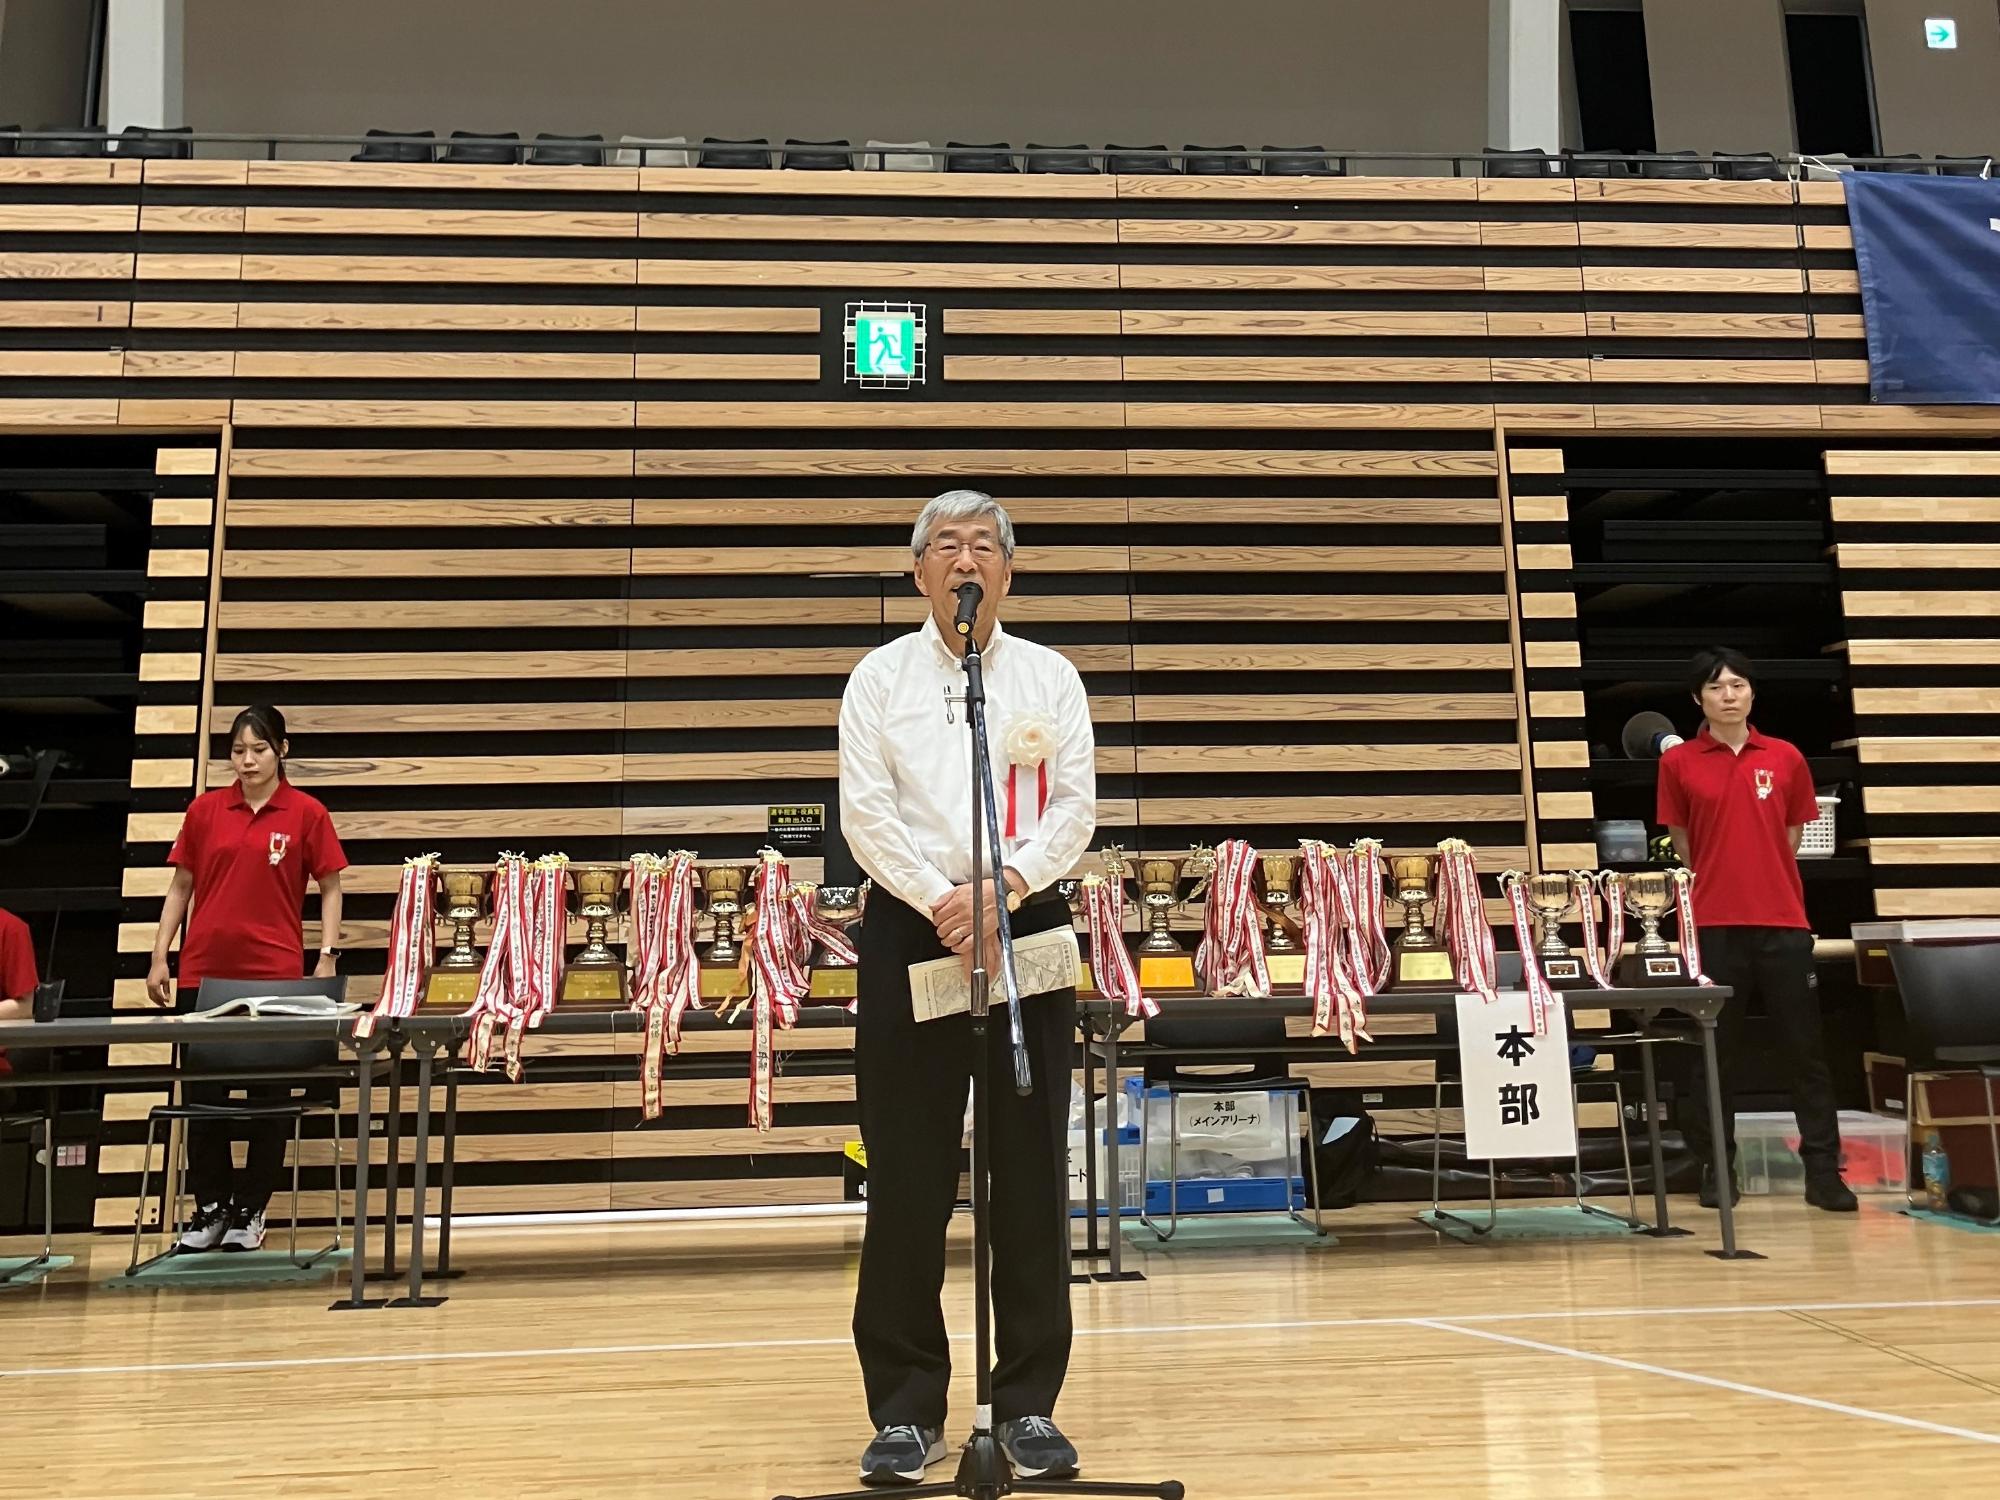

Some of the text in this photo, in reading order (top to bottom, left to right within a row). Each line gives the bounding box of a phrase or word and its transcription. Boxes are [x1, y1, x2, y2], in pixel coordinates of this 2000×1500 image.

[1495, 1024, 1540, 1126] 本部
[1214, 1101, 1235, 1112] 本部
[1190, 1113, 1261, 1127] (メインアリーナ)
